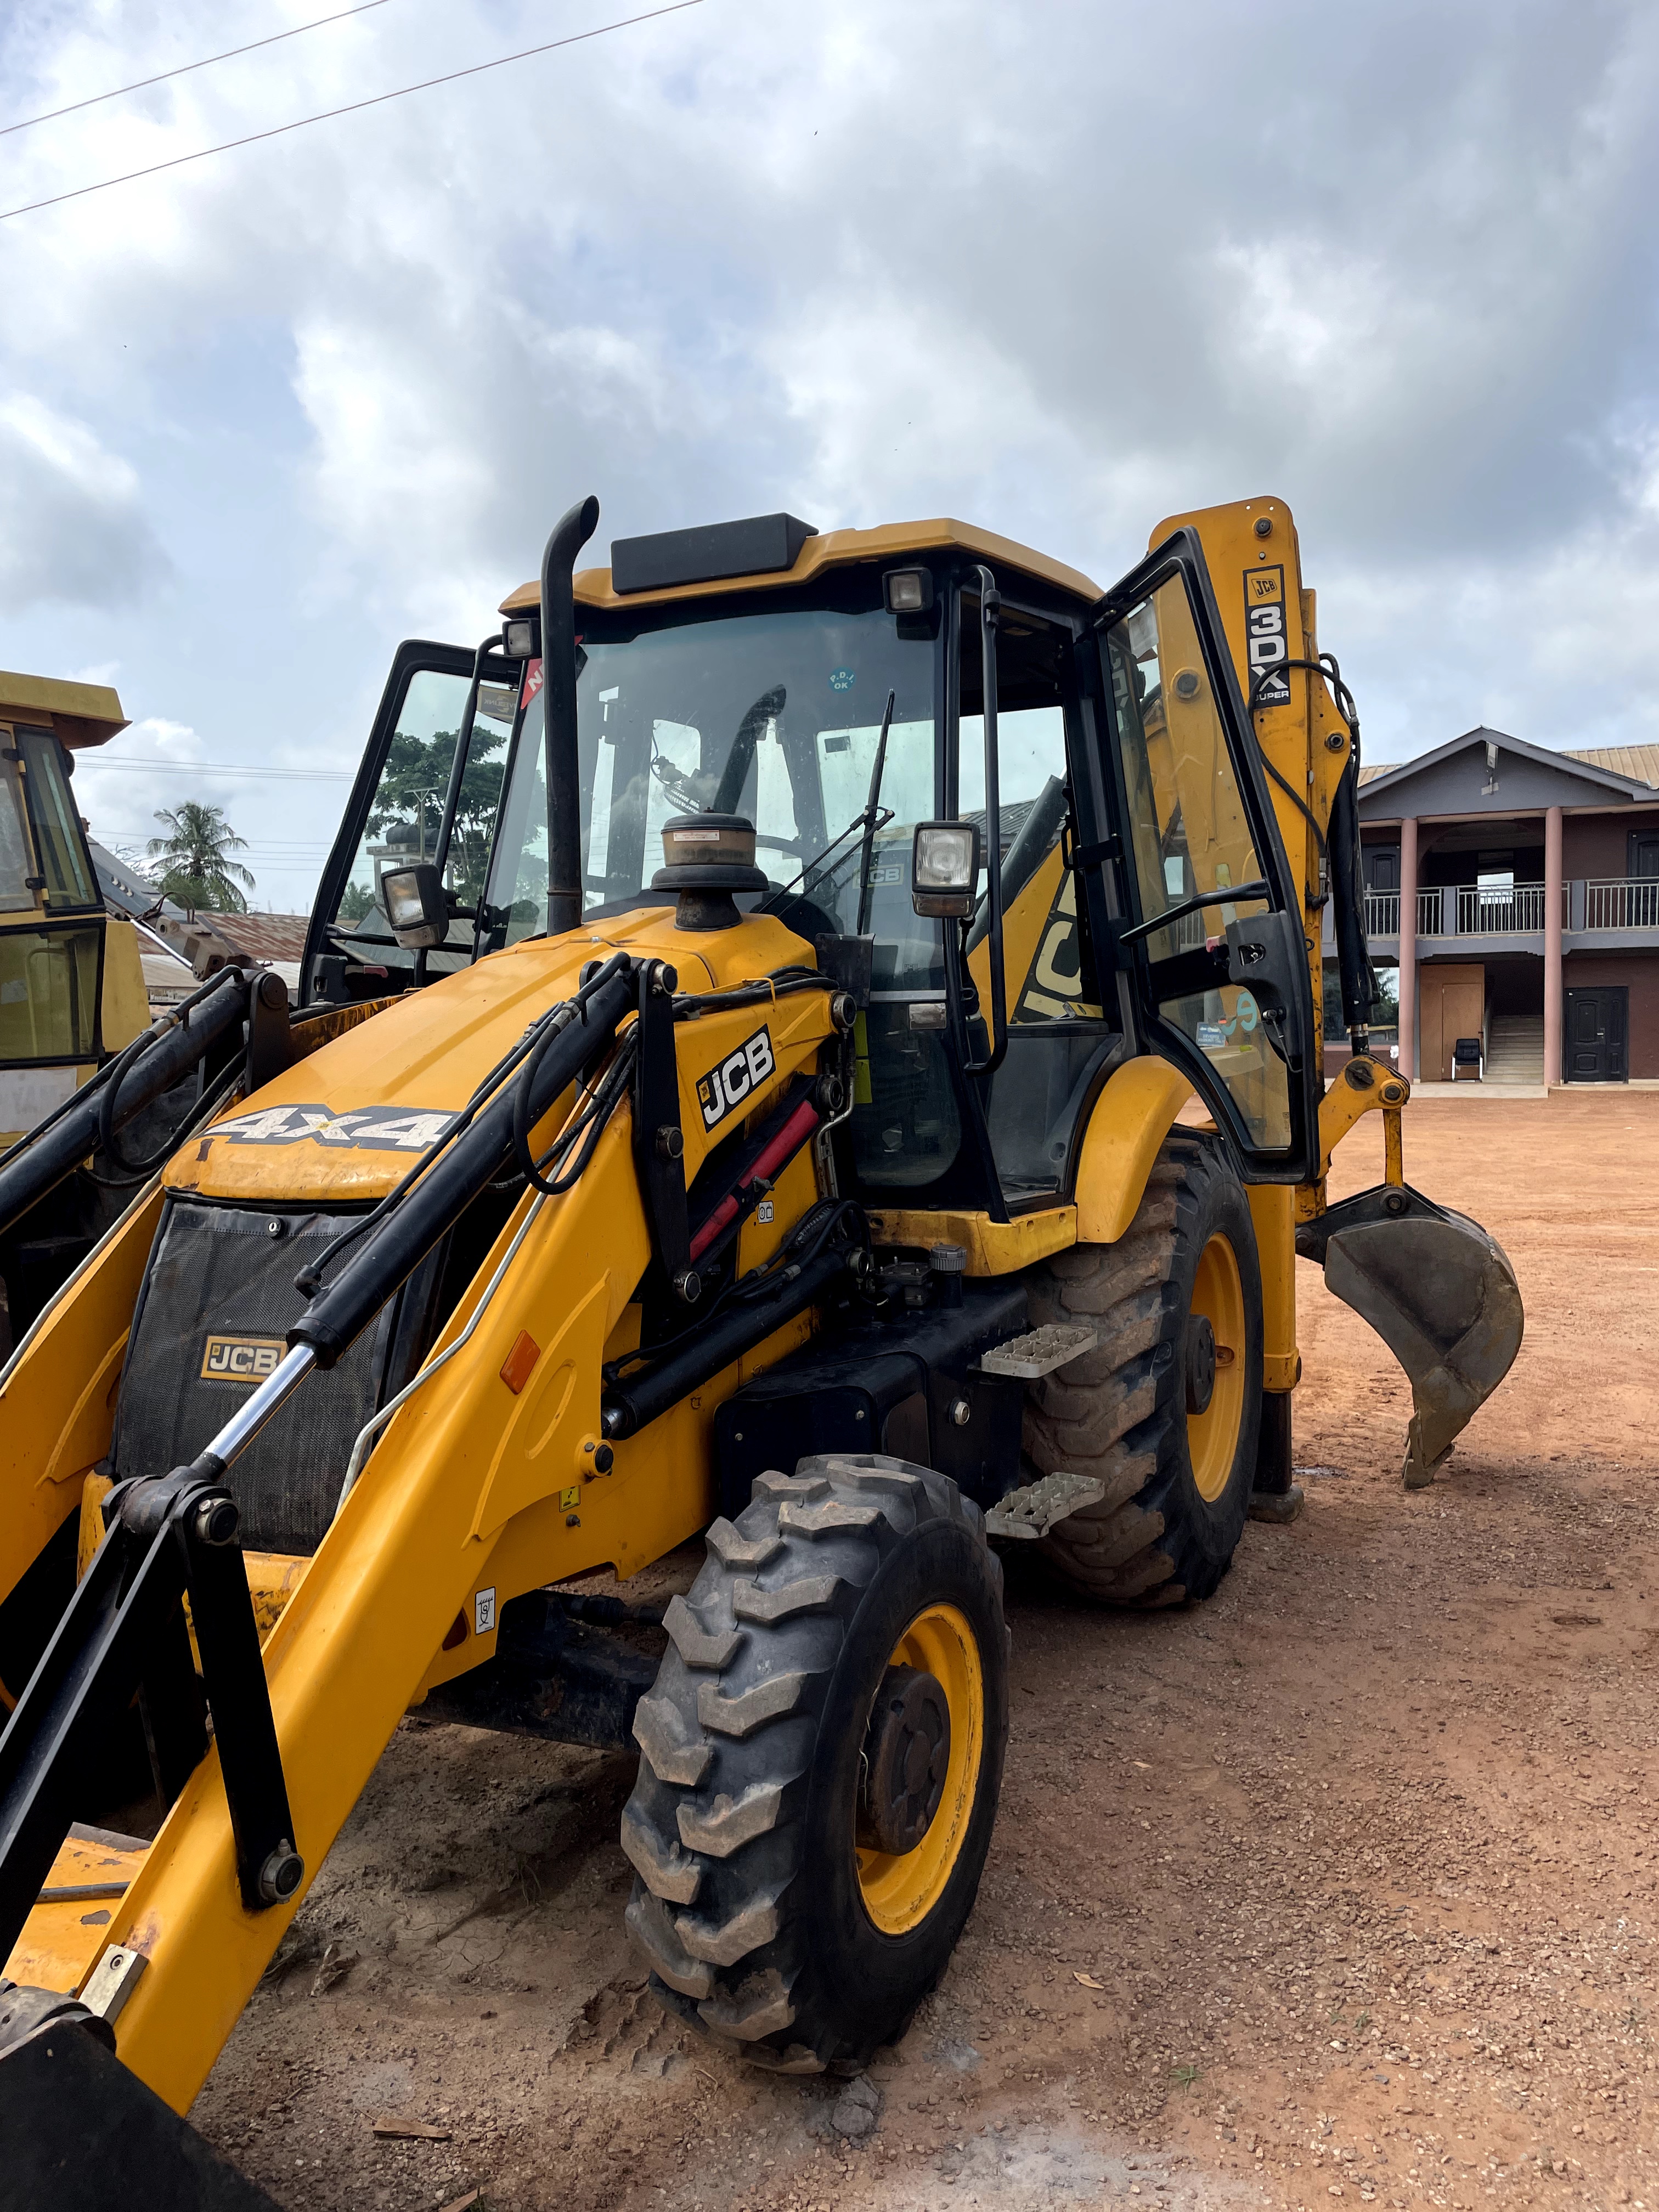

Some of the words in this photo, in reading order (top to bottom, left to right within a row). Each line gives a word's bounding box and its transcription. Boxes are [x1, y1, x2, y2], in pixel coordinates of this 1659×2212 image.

[1255, 579, 1276, 595] JCB
[857, 868, 900, 884] CB
[703, 1032, 773, 1125] JCB
[210, 1345, 278, 1374] JCB
